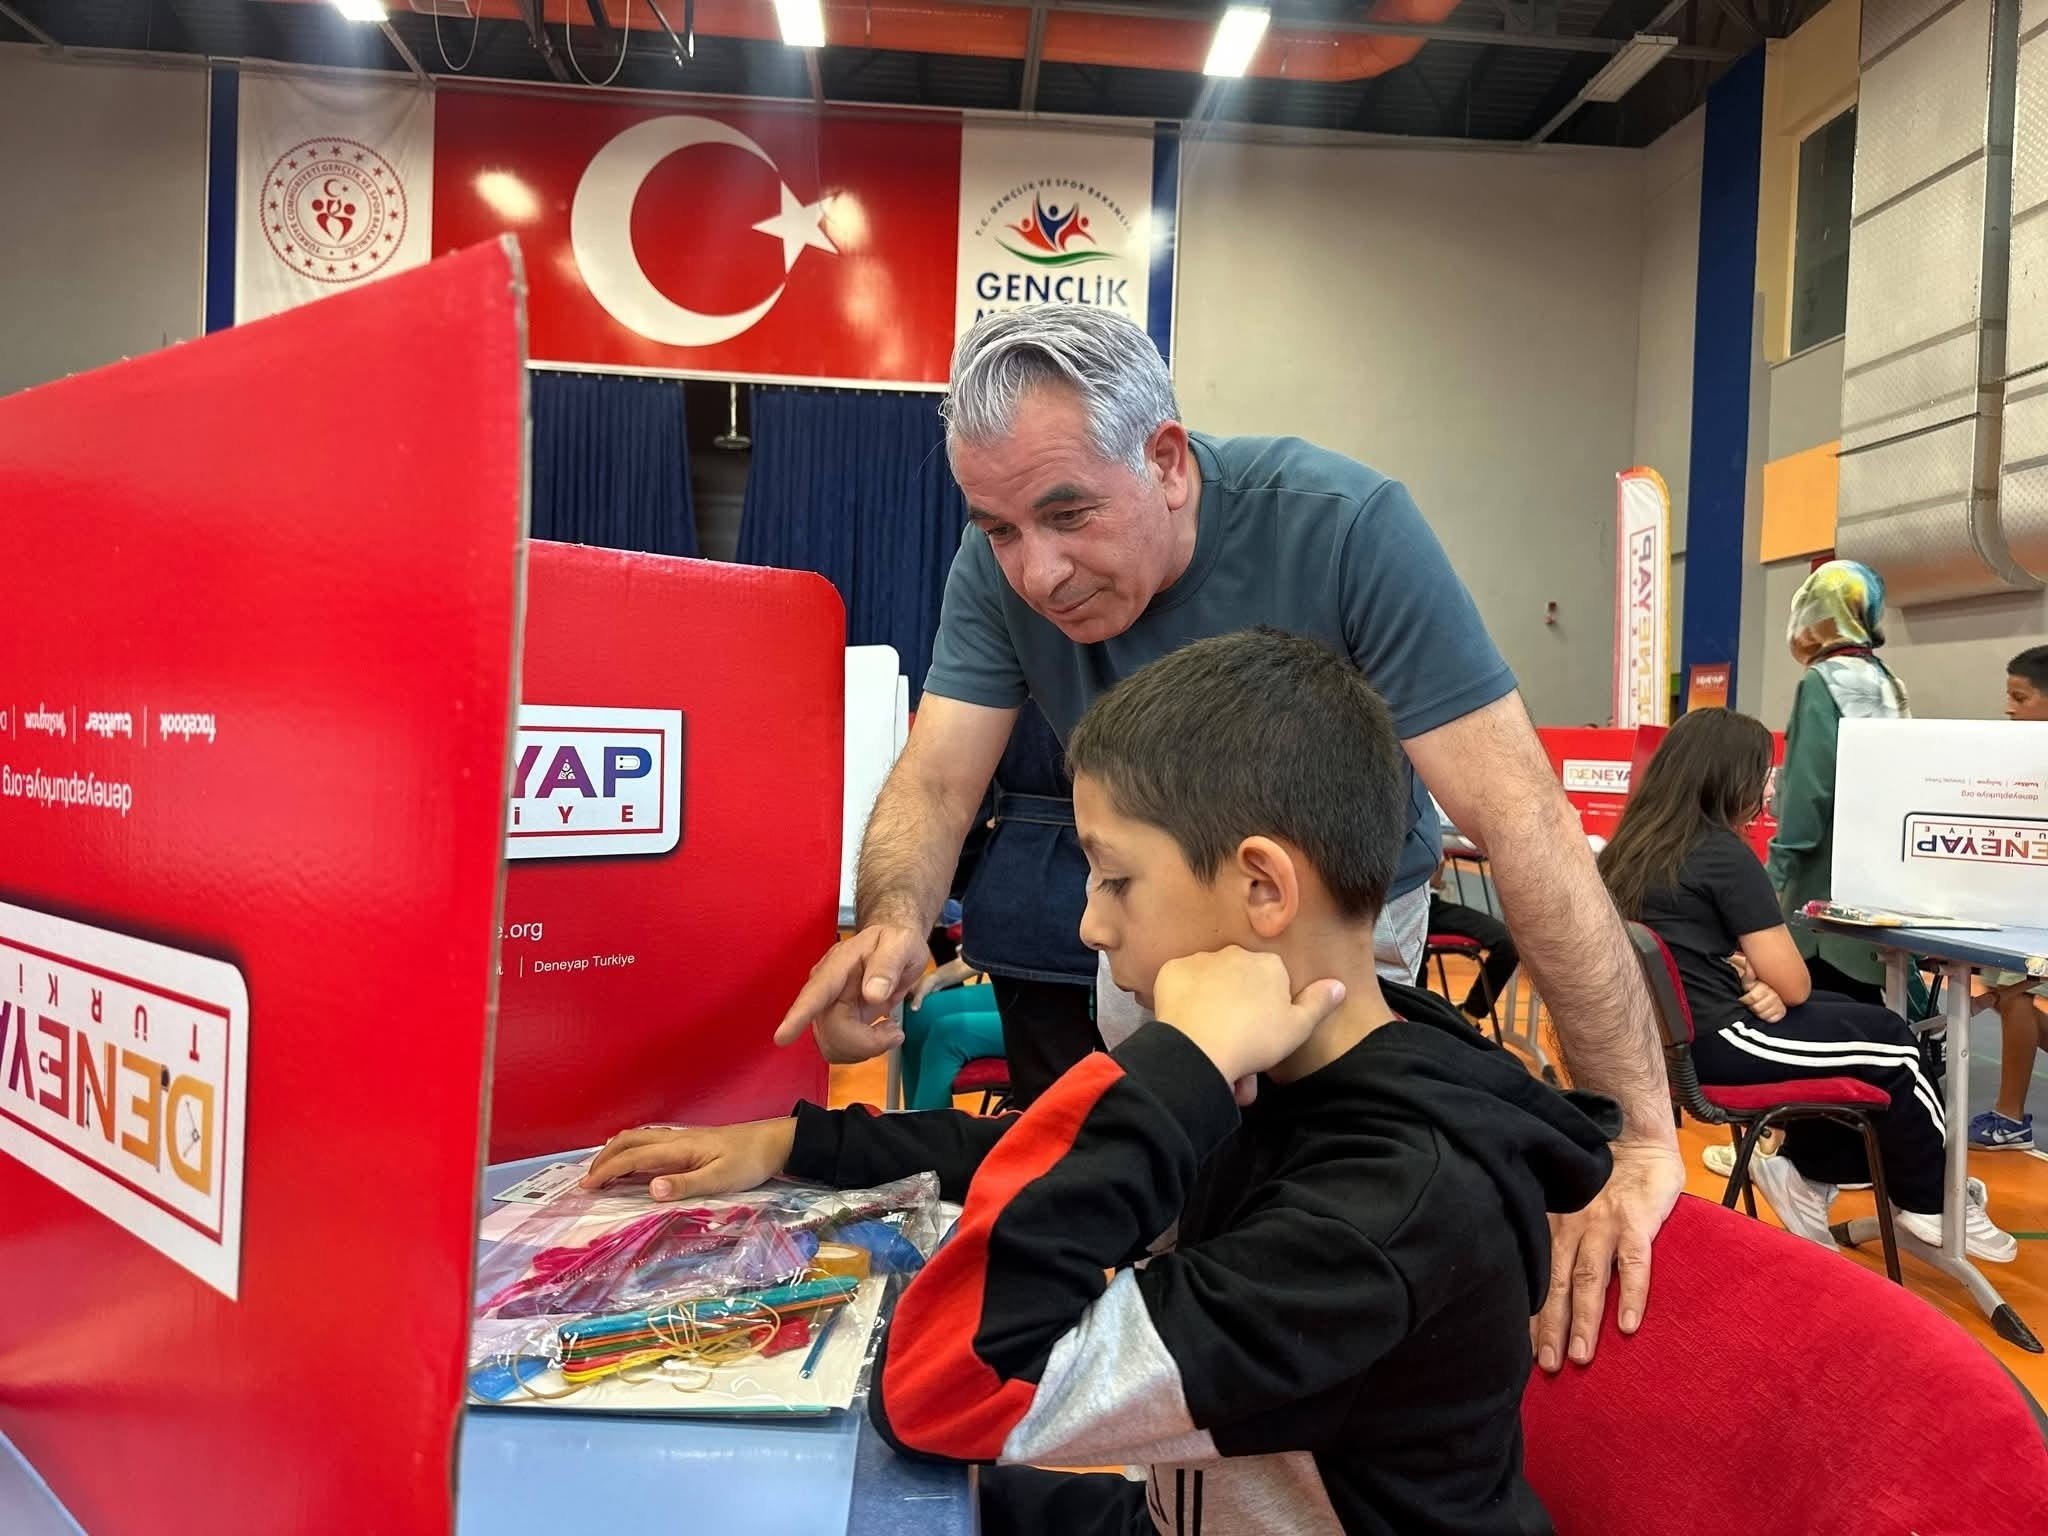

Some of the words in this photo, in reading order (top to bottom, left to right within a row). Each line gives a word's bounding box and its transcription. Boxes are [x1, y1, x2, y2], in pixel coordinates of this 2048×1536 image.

[976, 272, 1128, 306] GENÇLİK
[85, 711, 133, 739] twitter
[160, 712, 216, 744] facebook
[3, 765, 132, 818] deneyapturkiye.org
[534, 959, 589, 973] Deneyap
[592, 953, 635, 968] Turkiye
